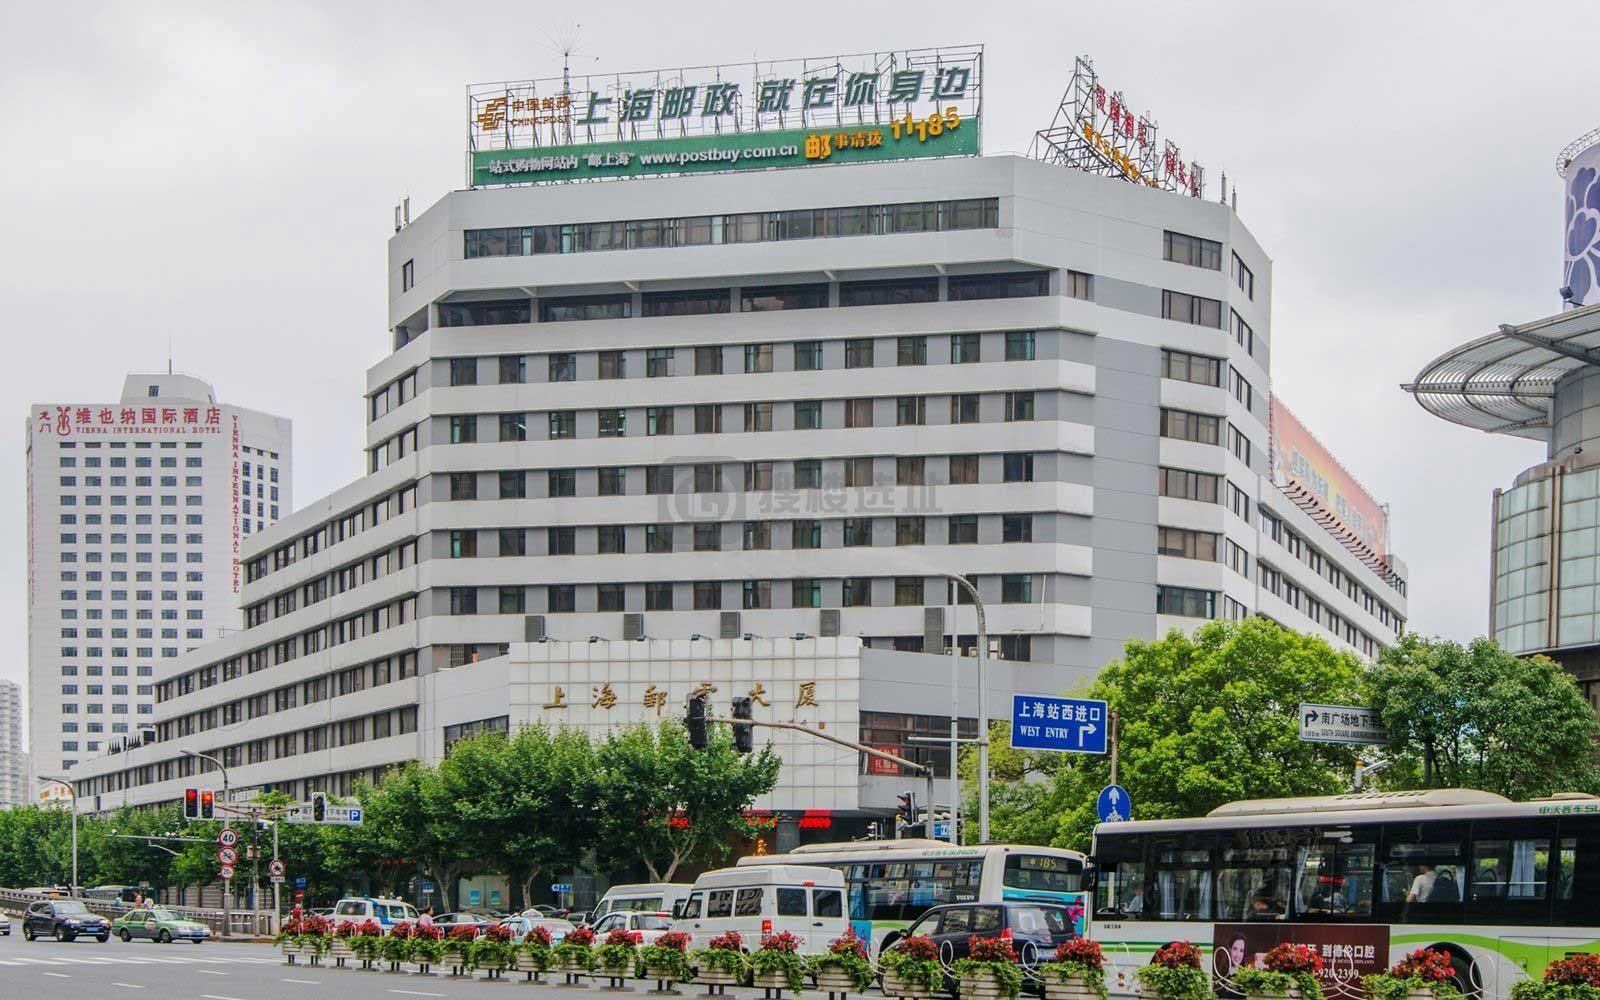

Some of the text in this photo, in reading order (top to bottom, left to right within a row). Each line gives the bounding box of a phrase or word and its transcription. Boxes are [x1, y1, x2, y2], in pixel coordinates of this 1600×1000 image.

[512, 96, 569, 111] 中国邮政
[577, 66, 971, 125] 上海邮政 就在你身边
[891, 106, 960, 142] 11185
[640, 145, 798, 166] www.postbuy.com.cn
[76, 407, 221, 425] 维也纳国际酒店
[232, 461, 240, 553] INTERNATIONAL
[232, 558, 240, 594] HOTEL
[1018, 701, 1100, 722] 上海站西进口
[1321, 712, 1385, 728] 南广场地下车
[1020, 725, 1069, 739] WEST ENTRY
[222, 834, 234, 842] 40
[1039, 855, 1057, 869] 185
